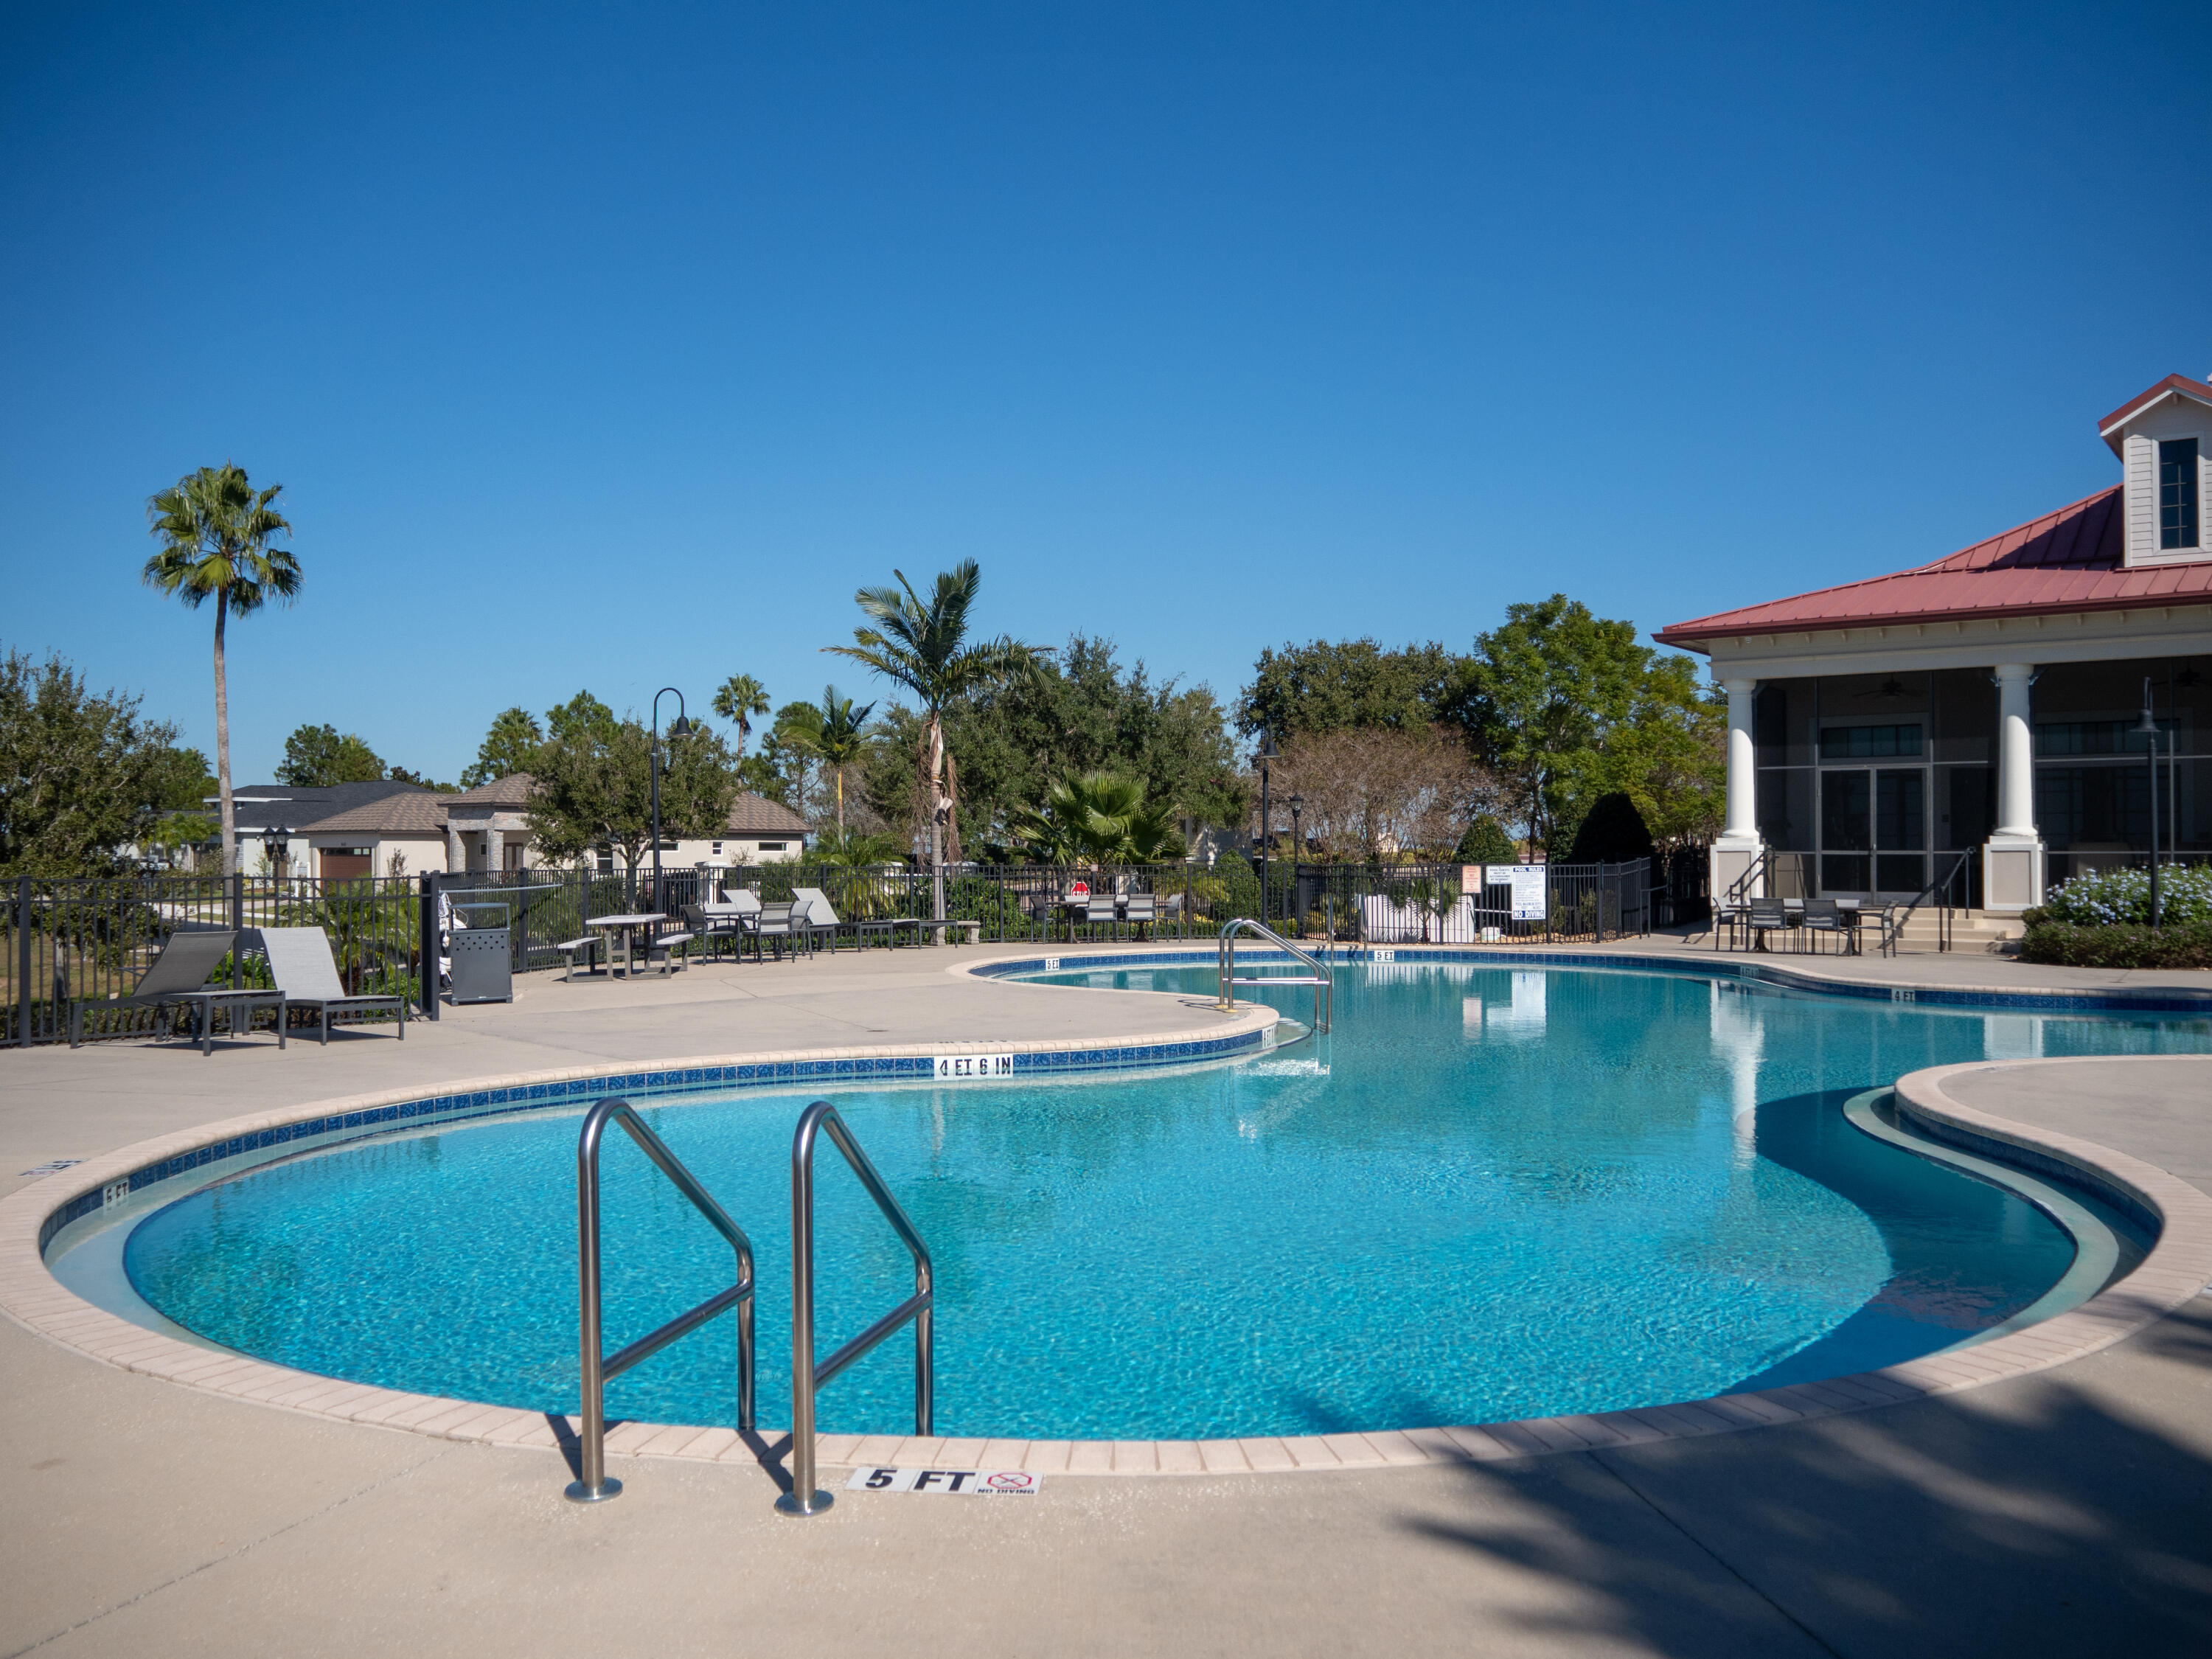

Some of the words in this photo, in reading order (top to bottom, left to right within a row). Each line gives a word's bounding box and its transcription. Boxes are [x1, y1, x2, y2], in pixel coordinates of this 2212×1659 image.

[1525, 910, 1544, 918] DIVING
[1377, 952, 1382, 960] 5
[1895, 991, 1899, 1002] 4
[1904, 991, 1914, 1002] FT
[940, 1060, 947, 1075] 4
[980, 1058, 987, 1074] 6
[995, 1057, 1010, 1074] IN
[107, 1188, 112, 1203] 5
[116, 1182, 127, 1198] FT
[866, 1470, 897, 1489] 5
[913, 1471, 975, 1491] FT
